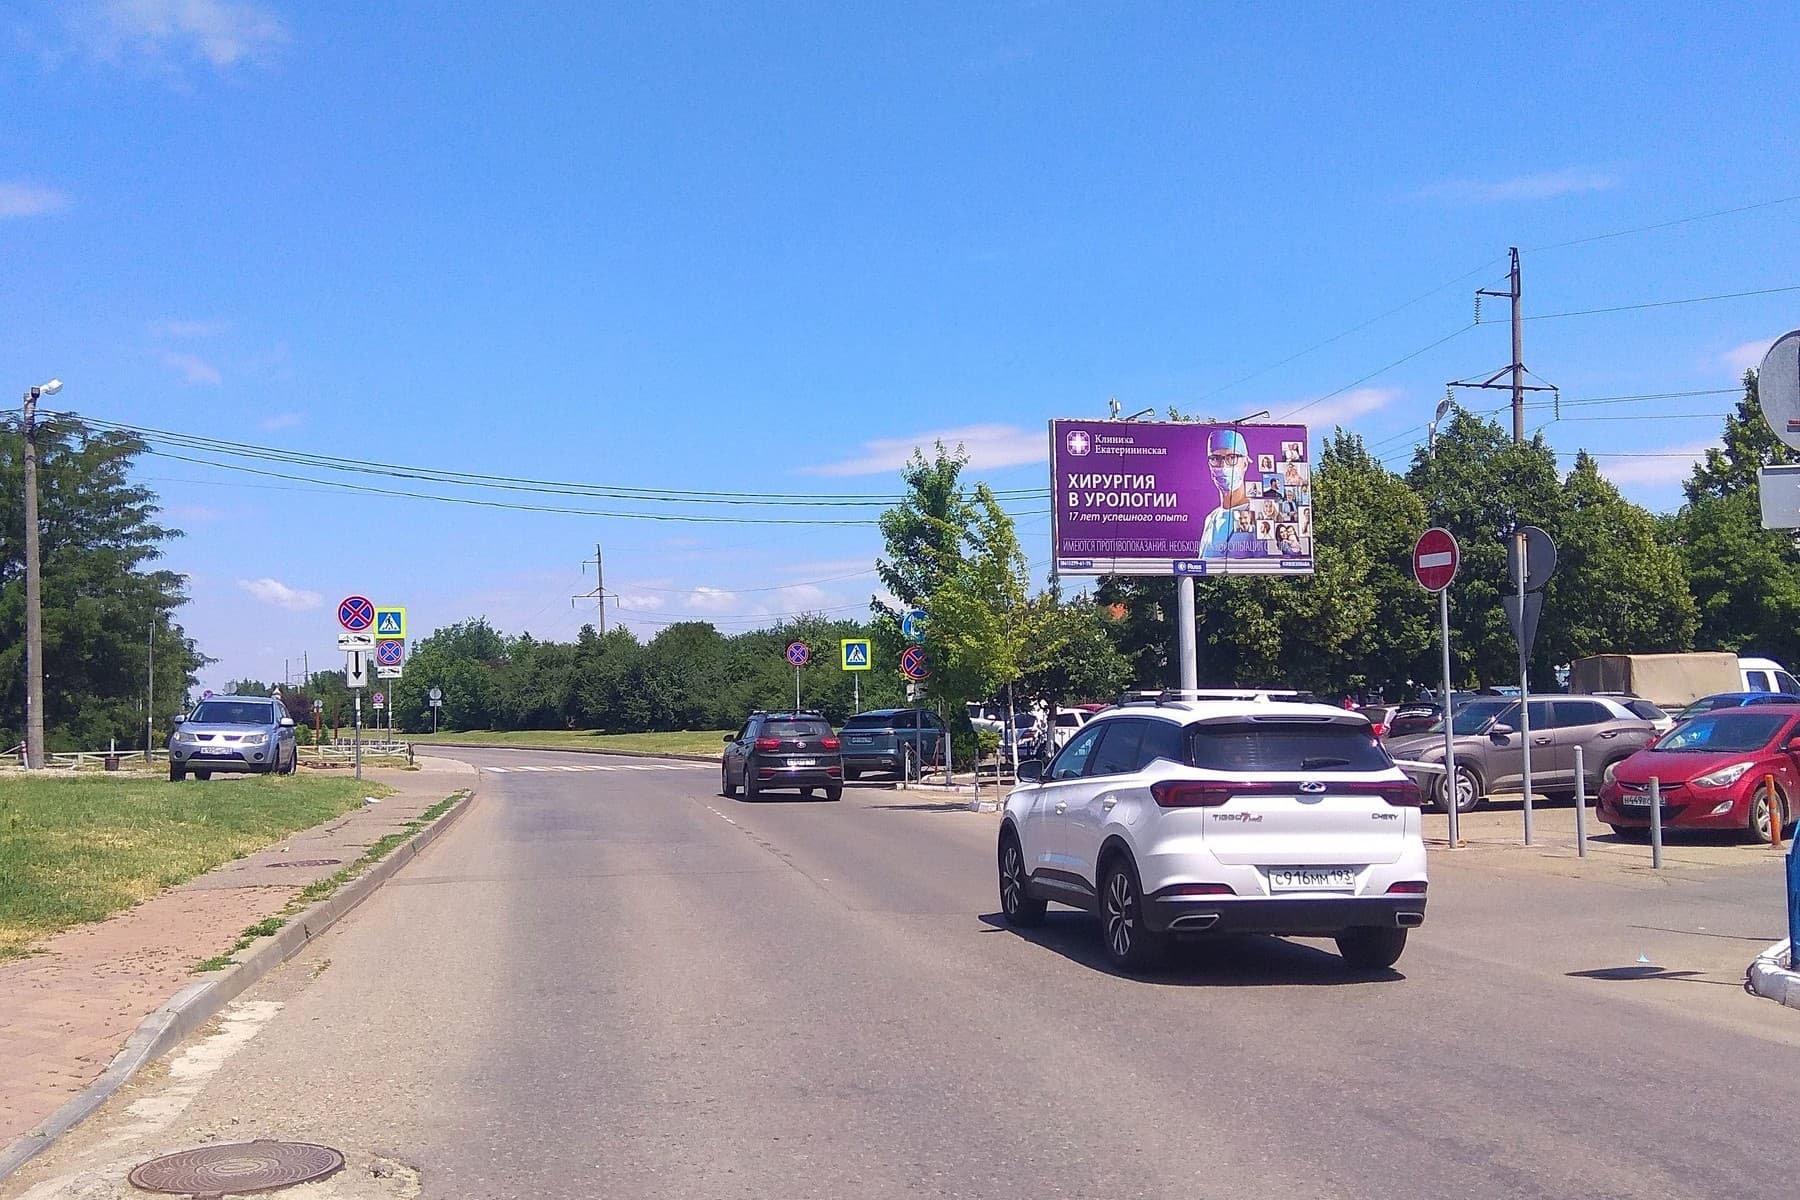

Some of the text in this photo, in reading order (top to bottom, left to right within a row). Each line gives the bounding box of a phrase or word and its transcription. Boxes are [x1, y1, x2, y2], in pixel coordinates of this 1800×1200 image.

[1095, 434, 1134, 444] Клиника
[1095, 445, 1167, 457] Екатерининская
[1068, 473, 1155, 489] ХИРУРГИЯ
[1068, 492, 1177, 508] В УРОЛОГИИ
[1068, 512, 1188, 523] 17 лет успешного опыта
[1063, 540, 1095, 552] ИМЕЮТСЯ
[1371, 812, 1399, 820] CHERY
